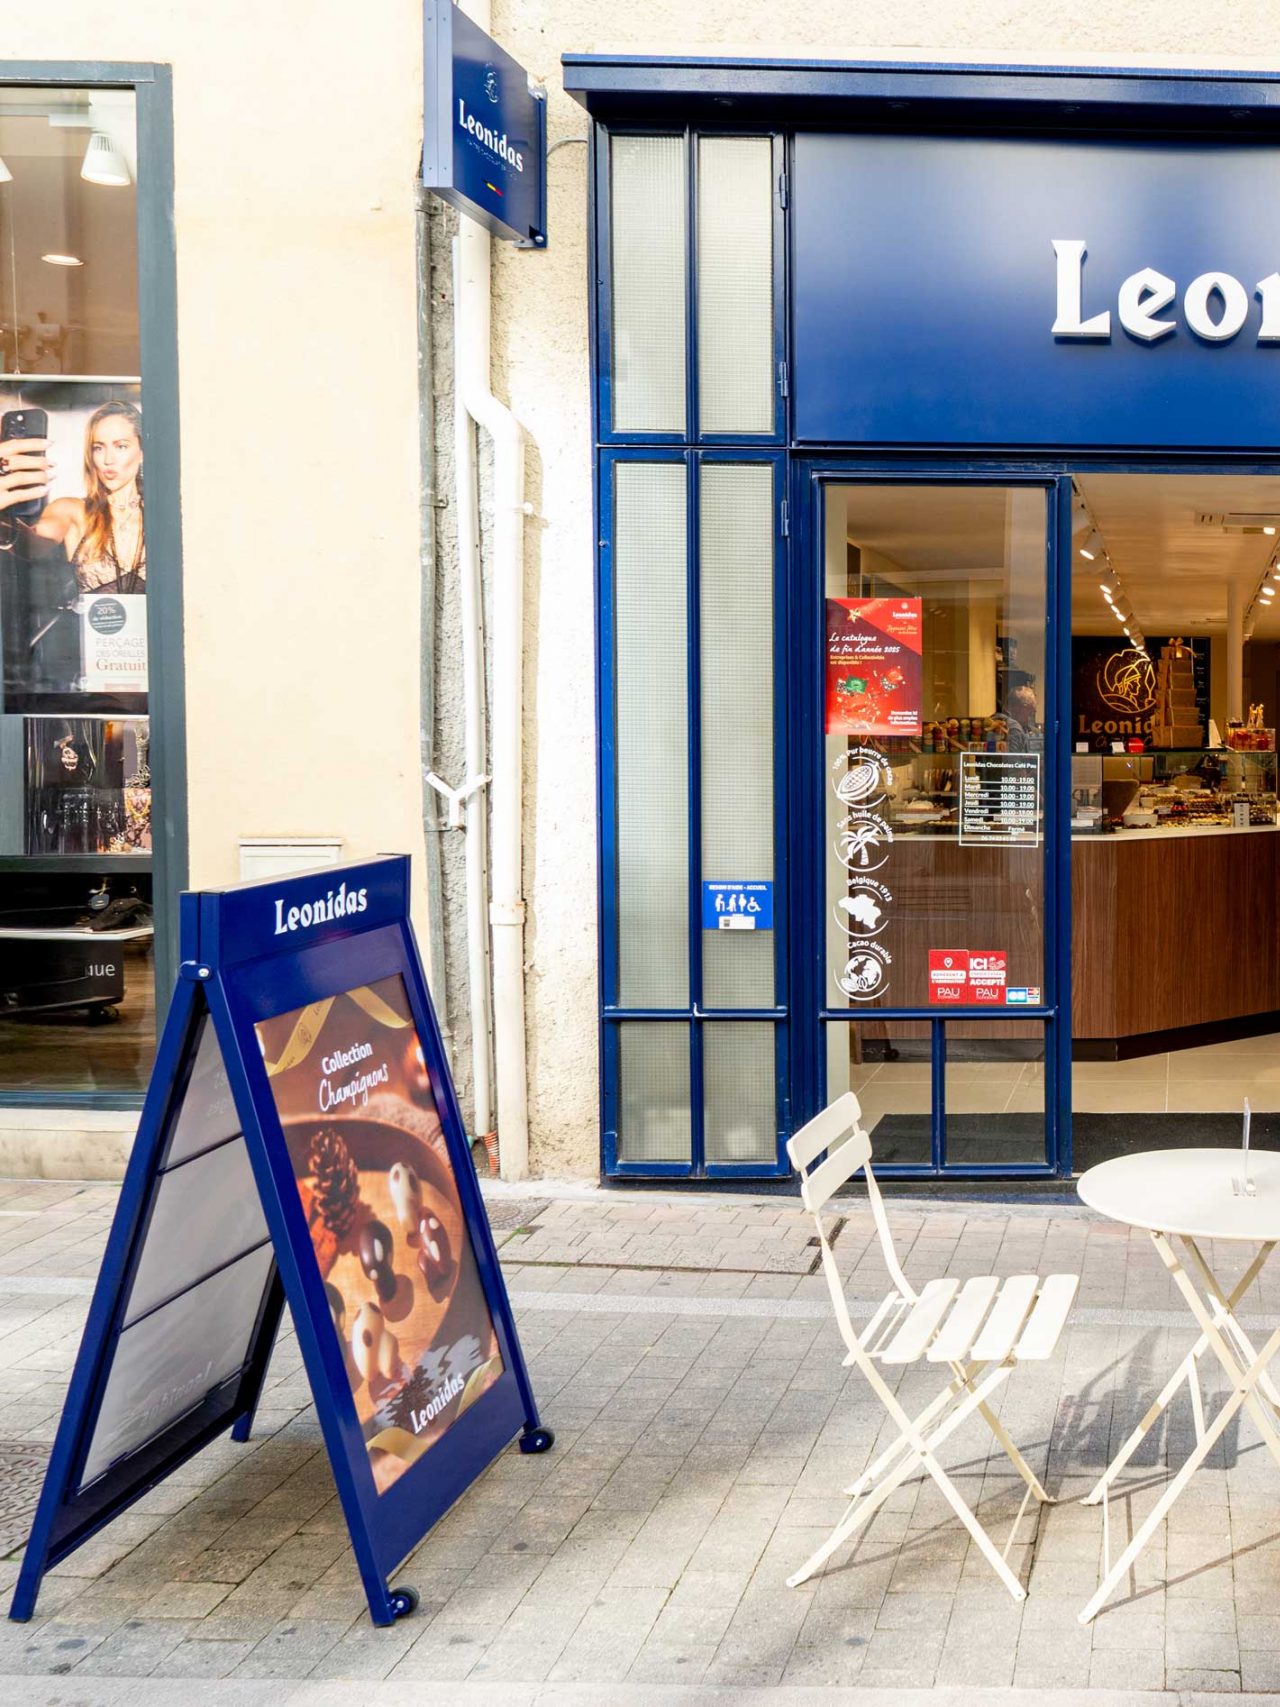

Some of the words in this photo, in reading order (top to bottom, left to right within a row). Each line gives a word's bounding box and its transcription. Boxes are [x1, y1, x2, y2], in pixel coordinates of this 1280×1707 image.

[459, 99, 523, 172] Leonidas
[829, 632, 840, 641] Le
[842, 633, 876, 647] catalogue
[842, 644, 853, 654] fin
[96, 659, 146, 671] Gratuit
[860, 746, 881, 759] beurre
[880, 758, 888, 766] de
[872, 814, 882, 822] de
[846, 876, 879, 887] Belgique
[879, 885, 893, 902] 1913
[274, 882, 367, 935] Leonidas
[847, 941, 869, 949] Cacao
[870, 941, 892, 964] durable
[970, 958, 987, 970] ICI
[938, 988, 959, 996] PAU
[976, 988, 998, 997] PAU
[322, 1042, 373, 1075] Collection
[319, 1063, 389, 1112] Champignons
[410, 1372, 464, 1434] Leonidas
